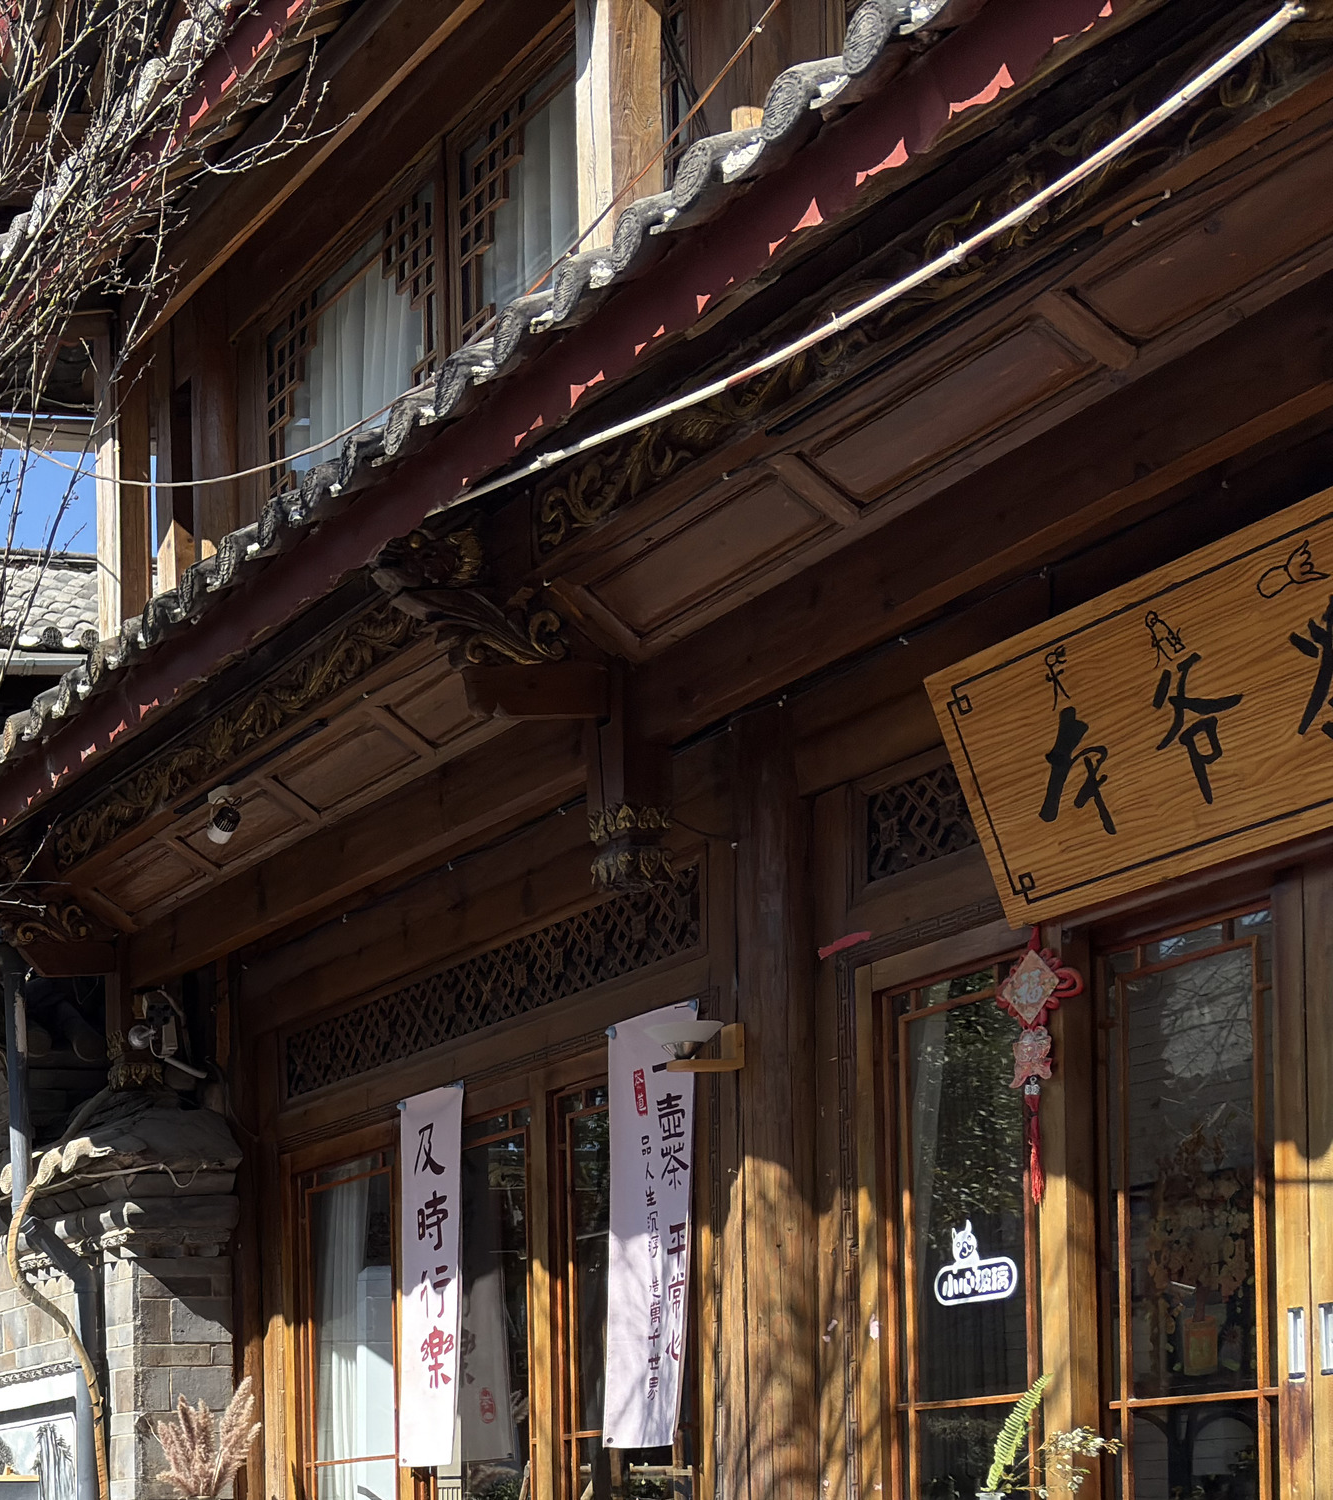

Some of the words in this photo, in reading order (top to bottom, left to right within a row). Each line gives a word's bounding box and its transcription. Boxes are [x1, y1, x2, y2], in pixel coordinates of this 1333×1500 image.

[413, 1122, 455, 1390] 及時行樂
[941, 1264, 1010, 1298] 小心玻璃
